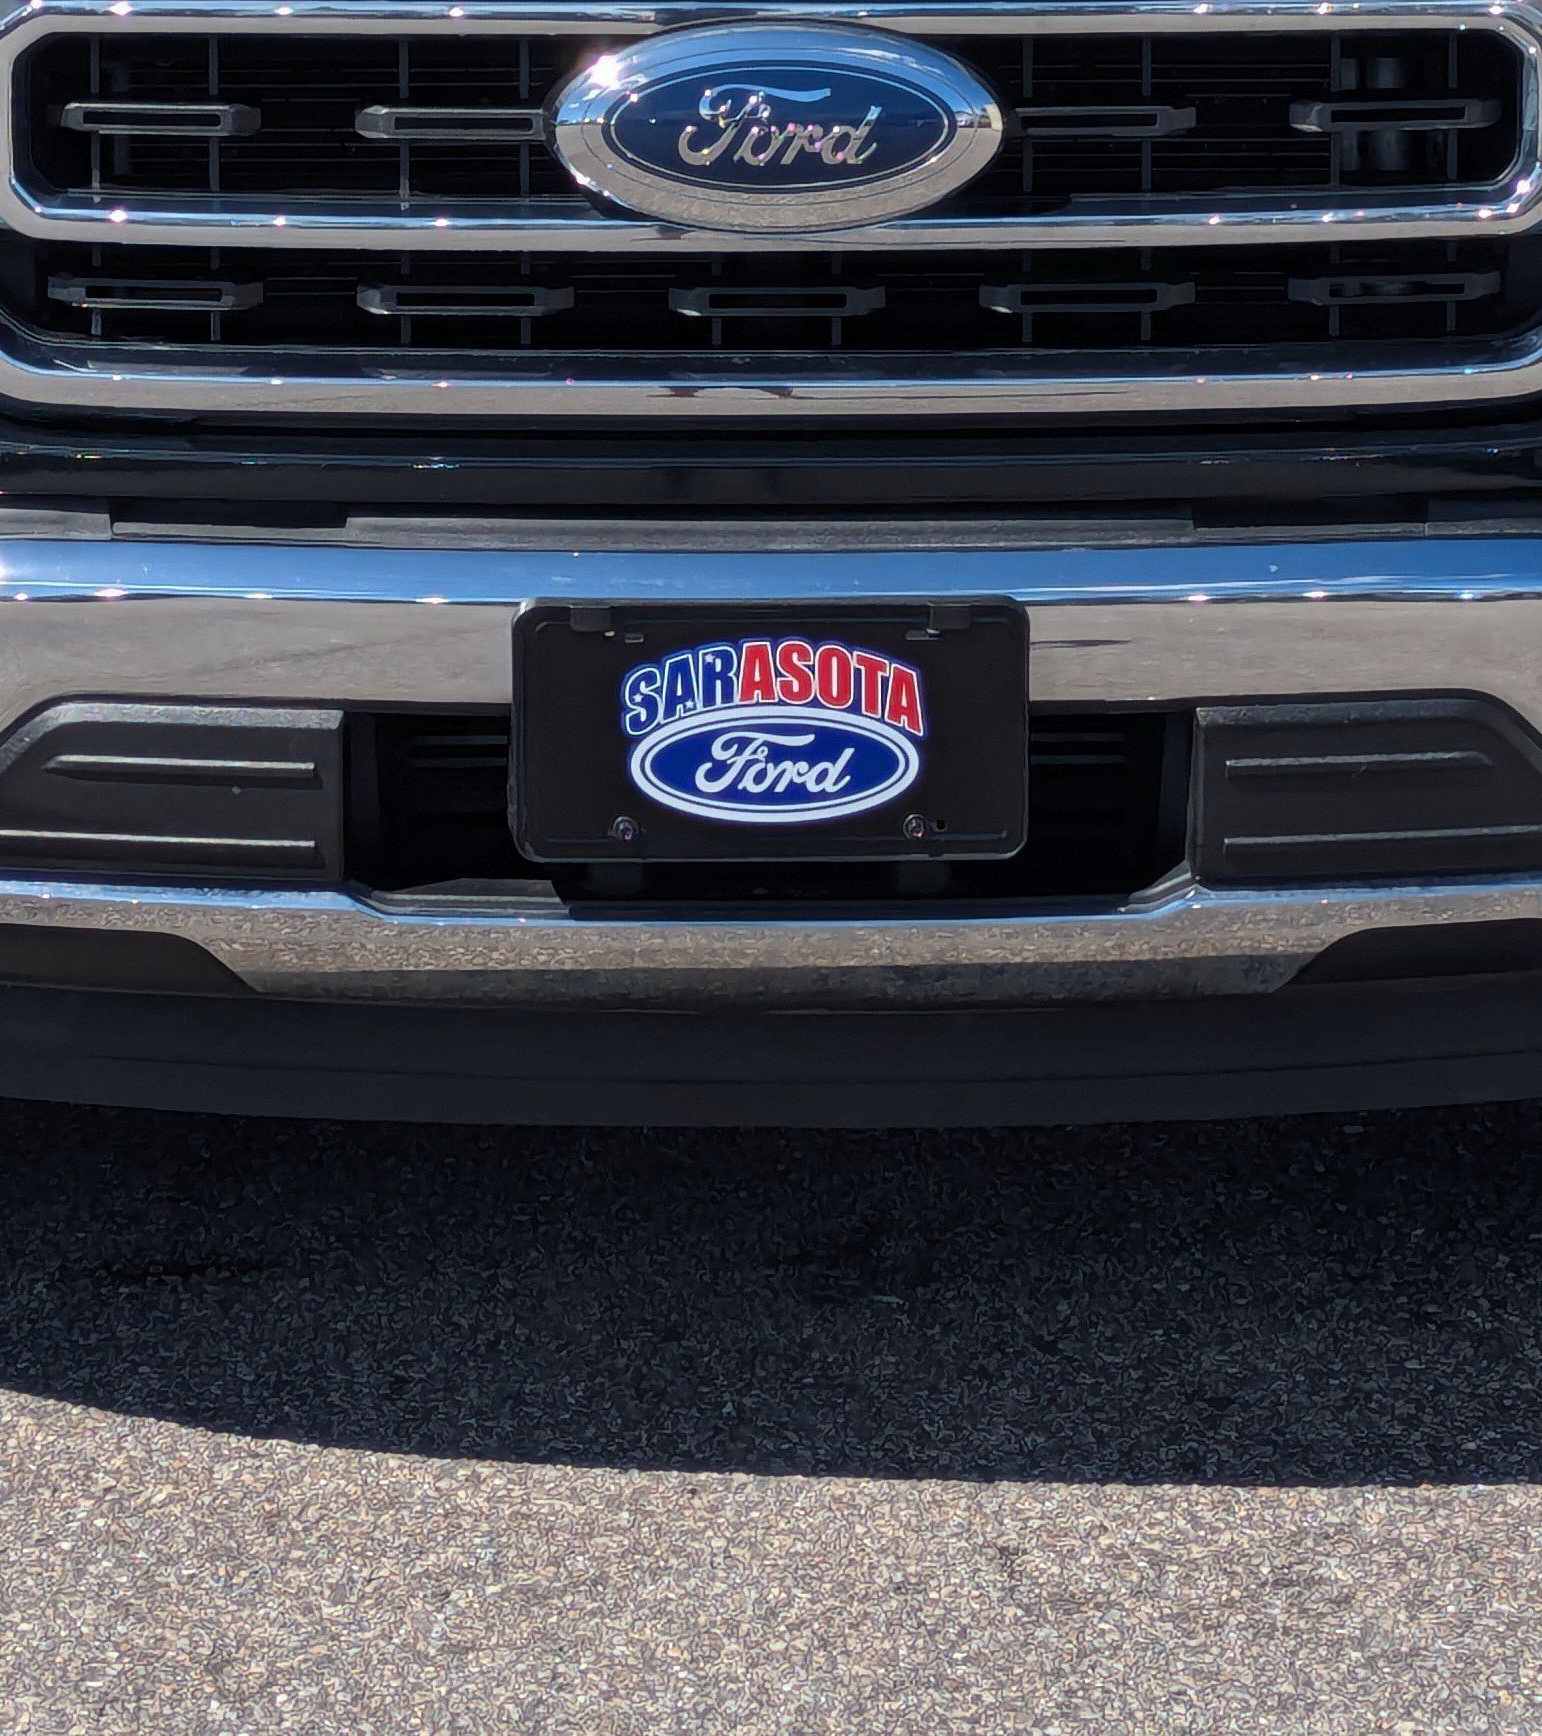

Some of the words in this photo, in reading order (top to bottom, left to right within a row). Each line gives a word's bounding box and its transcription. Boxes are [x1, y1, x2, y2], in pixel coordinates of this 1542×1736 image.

[677, 83, 883, 166] Ford
[623, 640, 925, 737] SARASOTA
[694, 730, 856, 795] Ford
